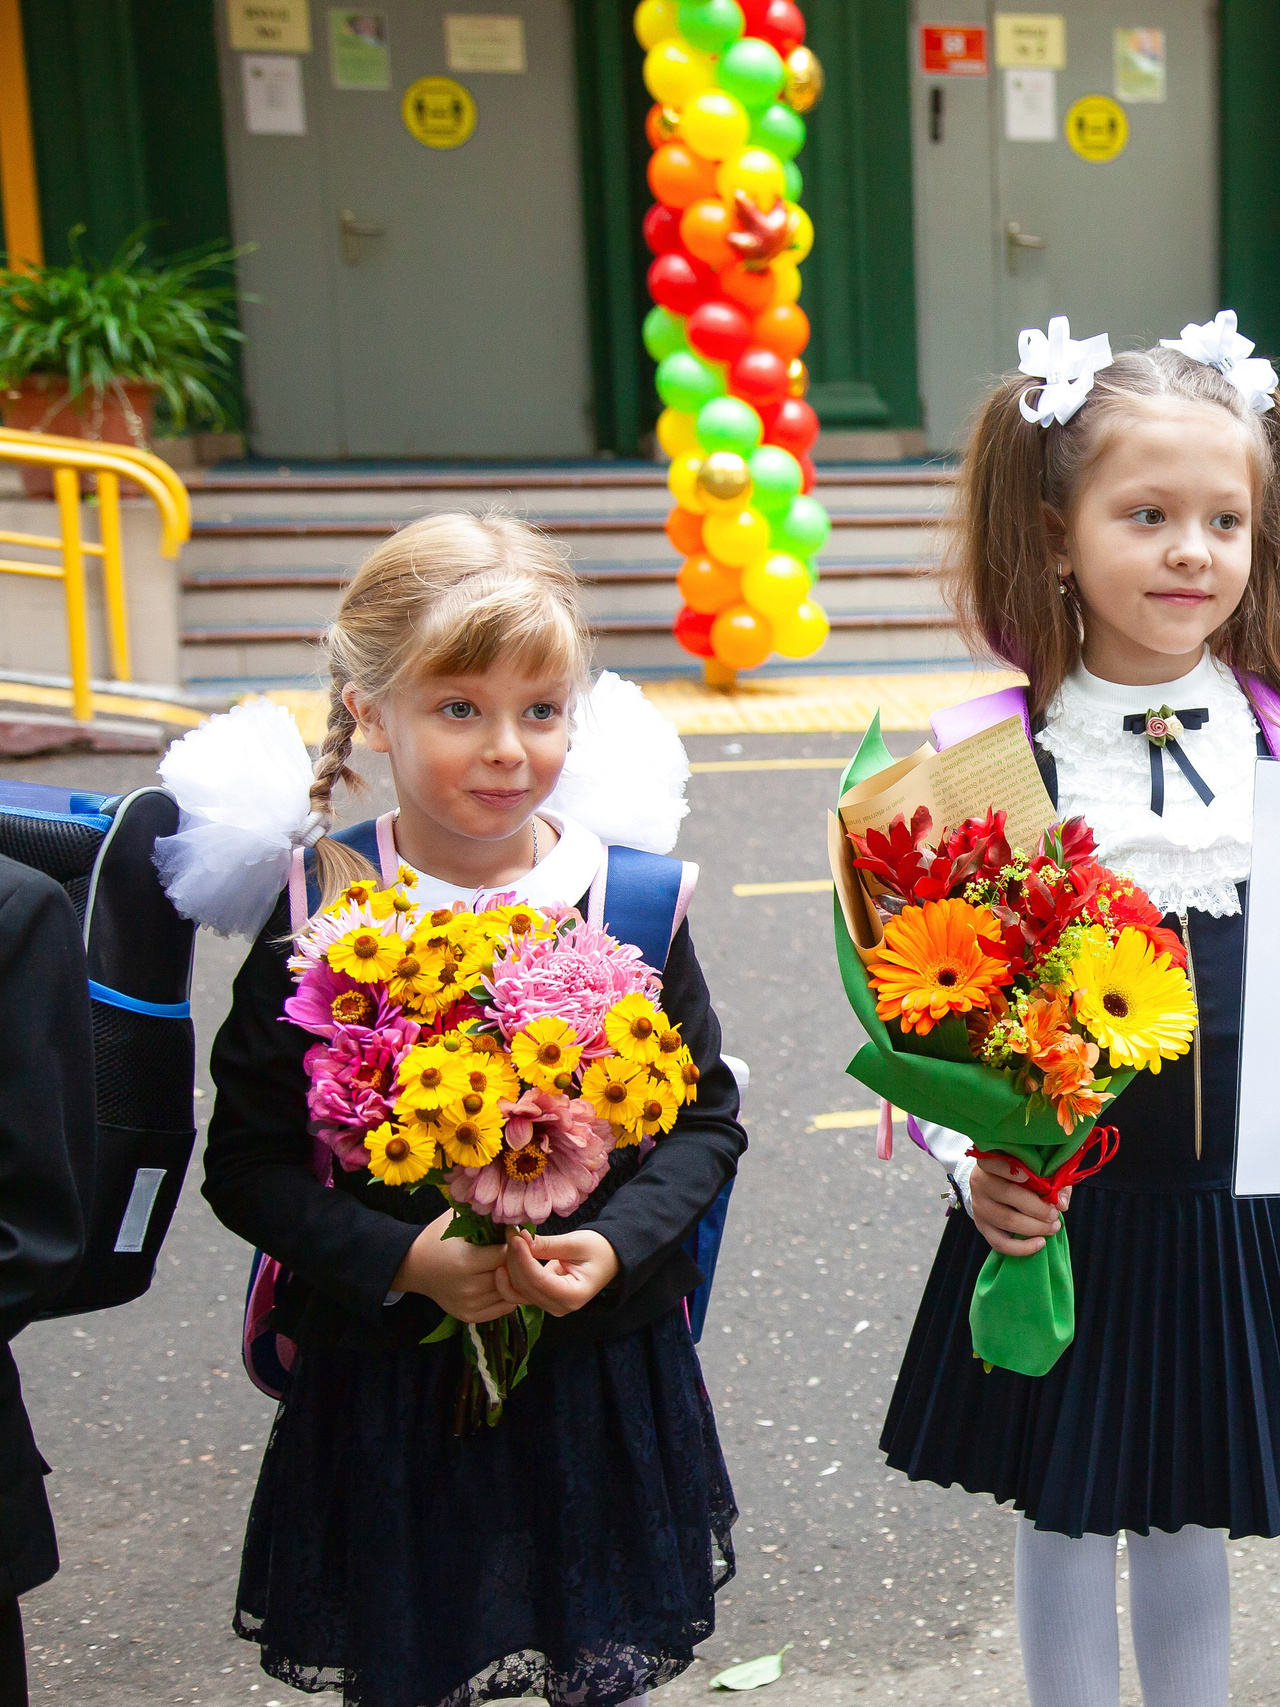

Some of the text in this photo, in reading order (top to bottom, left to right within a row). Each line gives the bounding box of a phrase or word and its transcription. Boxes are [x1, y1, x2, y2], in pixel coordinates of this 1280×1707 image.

[997, 726, 1008, 734] last
[1010, 735, 1026, 746] unday
[959, 745, 971, 753] was
[940, 751, 958, 763] wrong
[1016, 756, 1028, 764] was
[971, 758, 985, 767] noon,
[929, 771, 940, 780] love
[970, 764, 992, 778] working
[988, 767, 1006, 778] North,
[1028, 770, 1039, 779] But
[954, 776, 969, 787] week
[996, 774, 1012, 785] touch
[1008, 779, 1018, 789] you
[942, 784, 953, 794] and
[974, 788, 983, 797] yet
[984, 783, 994, 792] and
[993, 786, 1008, 797] know
[949, 792, 958, 800] my
[964, 794, 973, 803] not
[1010, 789, 1021, 799] and
[978, 795, 992, 805] what
[957, 804, 974, 817] think?
[1007, 801, 1018, 810] and
[1017, 801, 1036, 814] people
[863, 808, 885, 823] eternal
[1007, 831, 1021, 840] certa
